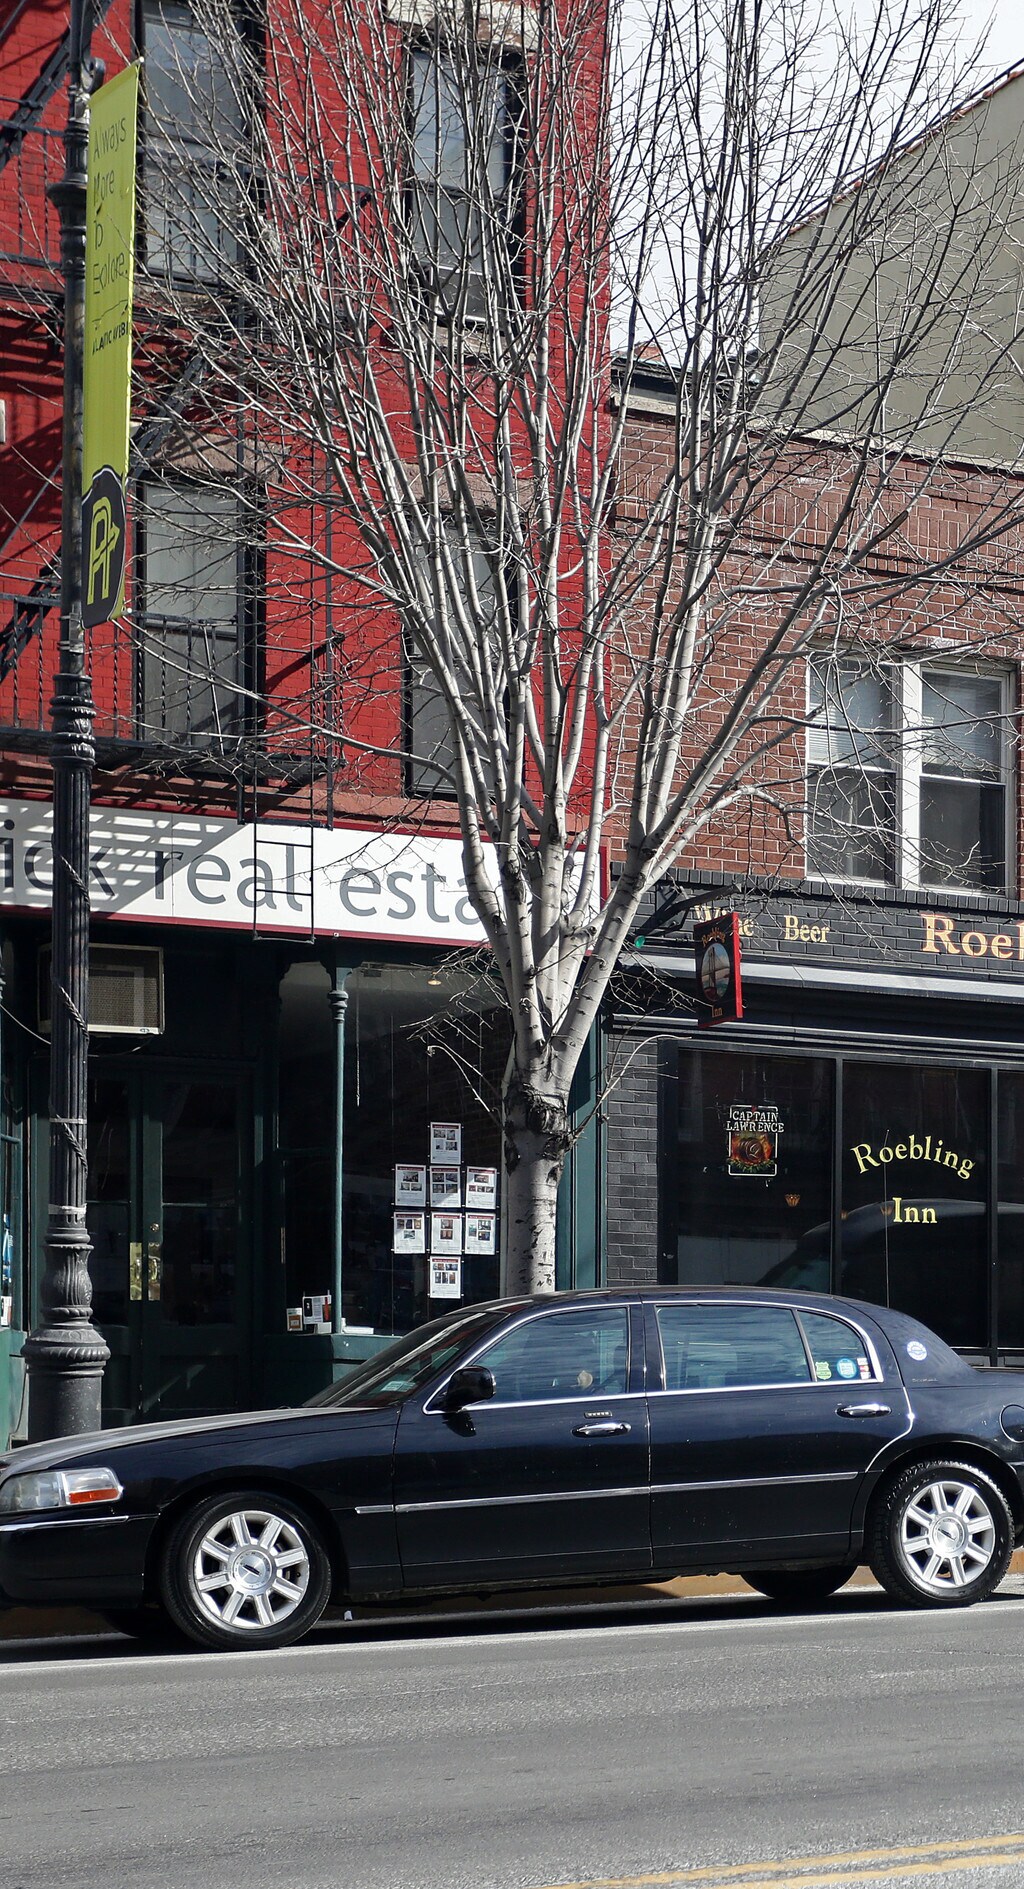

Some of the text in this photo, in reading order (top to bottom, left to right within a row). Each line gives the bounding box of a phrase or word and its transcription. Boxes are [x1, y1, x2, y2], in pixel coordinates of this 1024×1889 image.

[155, 845, 303, 912] real
[783, 914, 830, 943] Beer
[725, 1121, 785, 1133] LAWRENCE
[732, 1110, 779, 1123] CAPTAIN
[850, 1134, 976, 1180] Roebling
[892, 1197, 938, 1224] Inn
